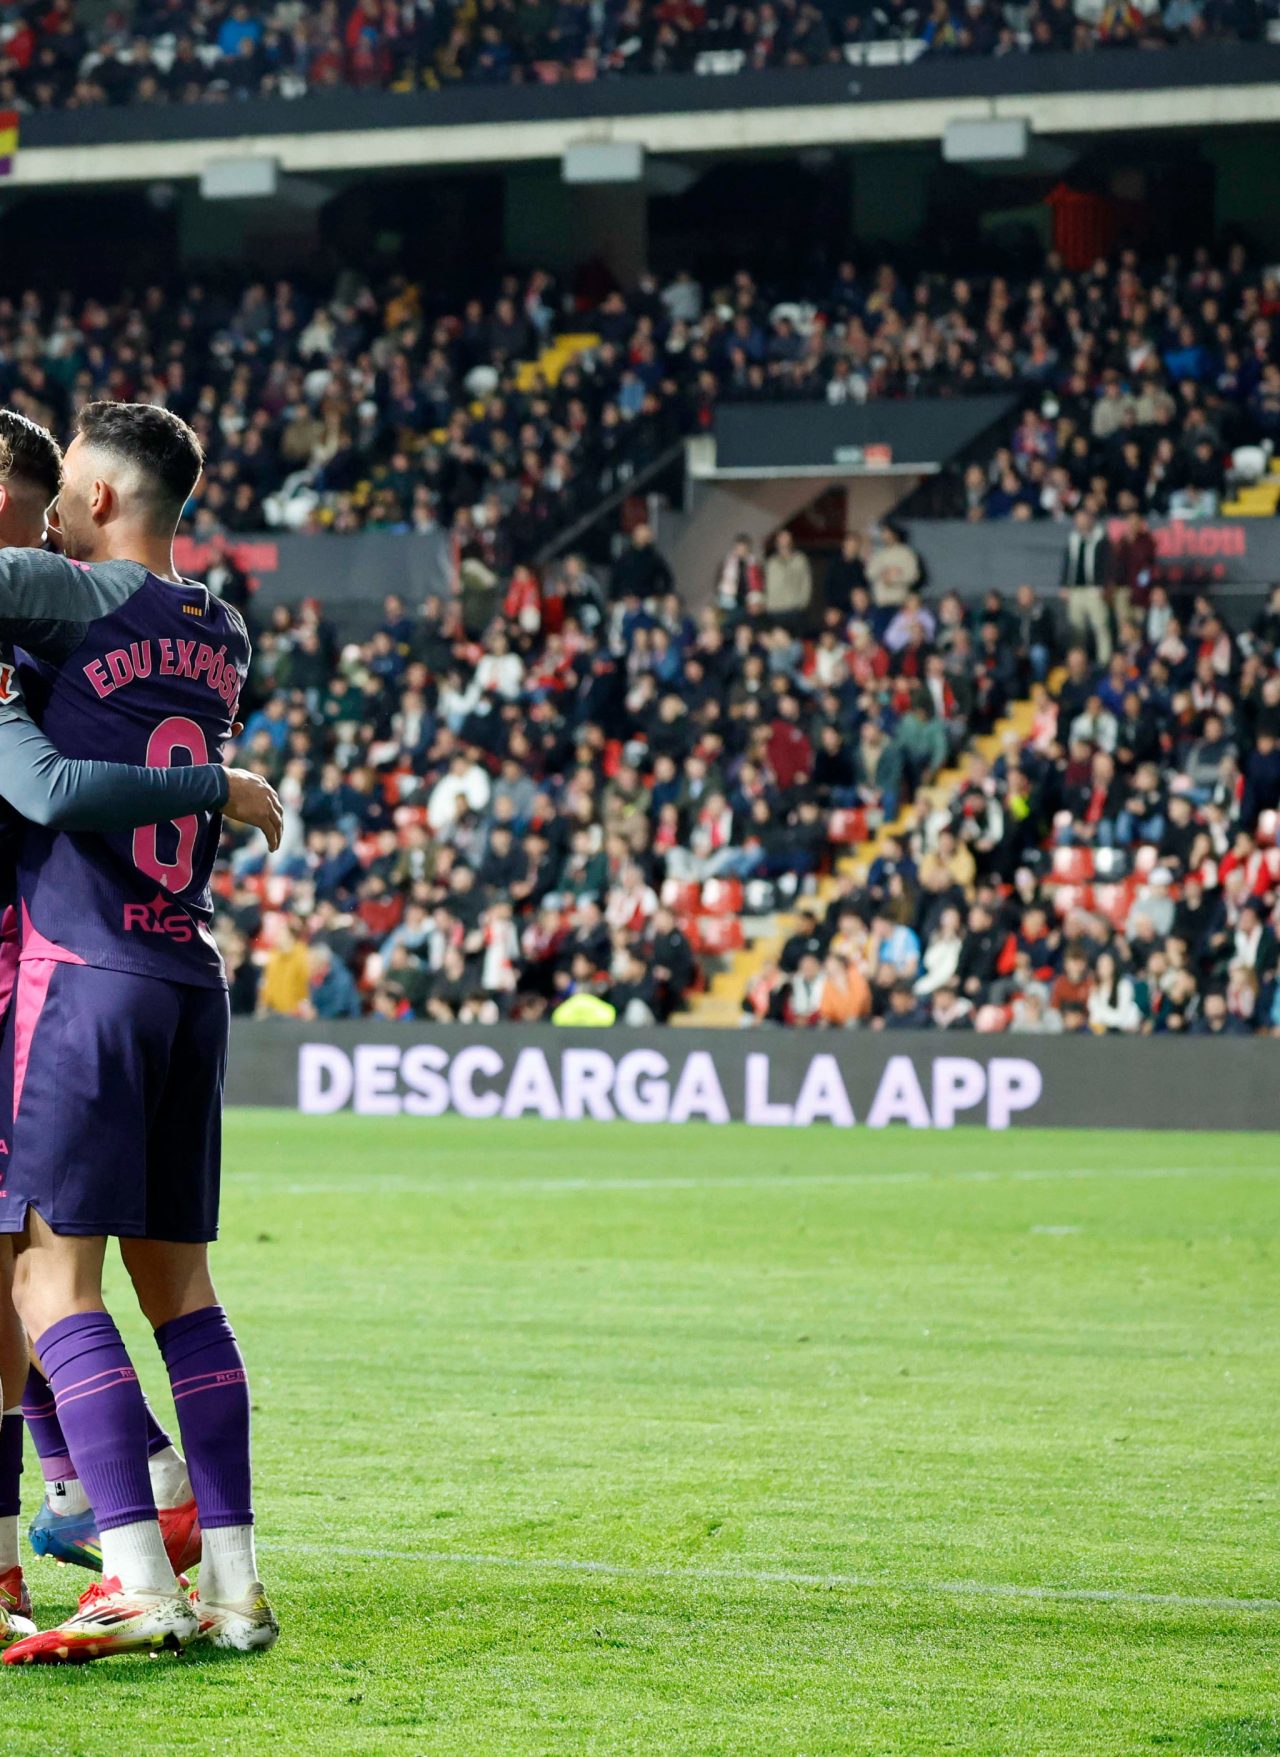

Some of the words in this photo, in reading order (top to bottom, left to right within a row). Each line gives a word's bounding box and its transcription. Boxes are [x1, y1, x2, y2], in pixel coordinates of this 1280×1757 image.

[83, 639, 152, 699] EDU
[298, 1043, 730, 1123] DESCARGA
[745, 1053, 855, 1127] LA
[867, 1056, 1042, 1130] APP
